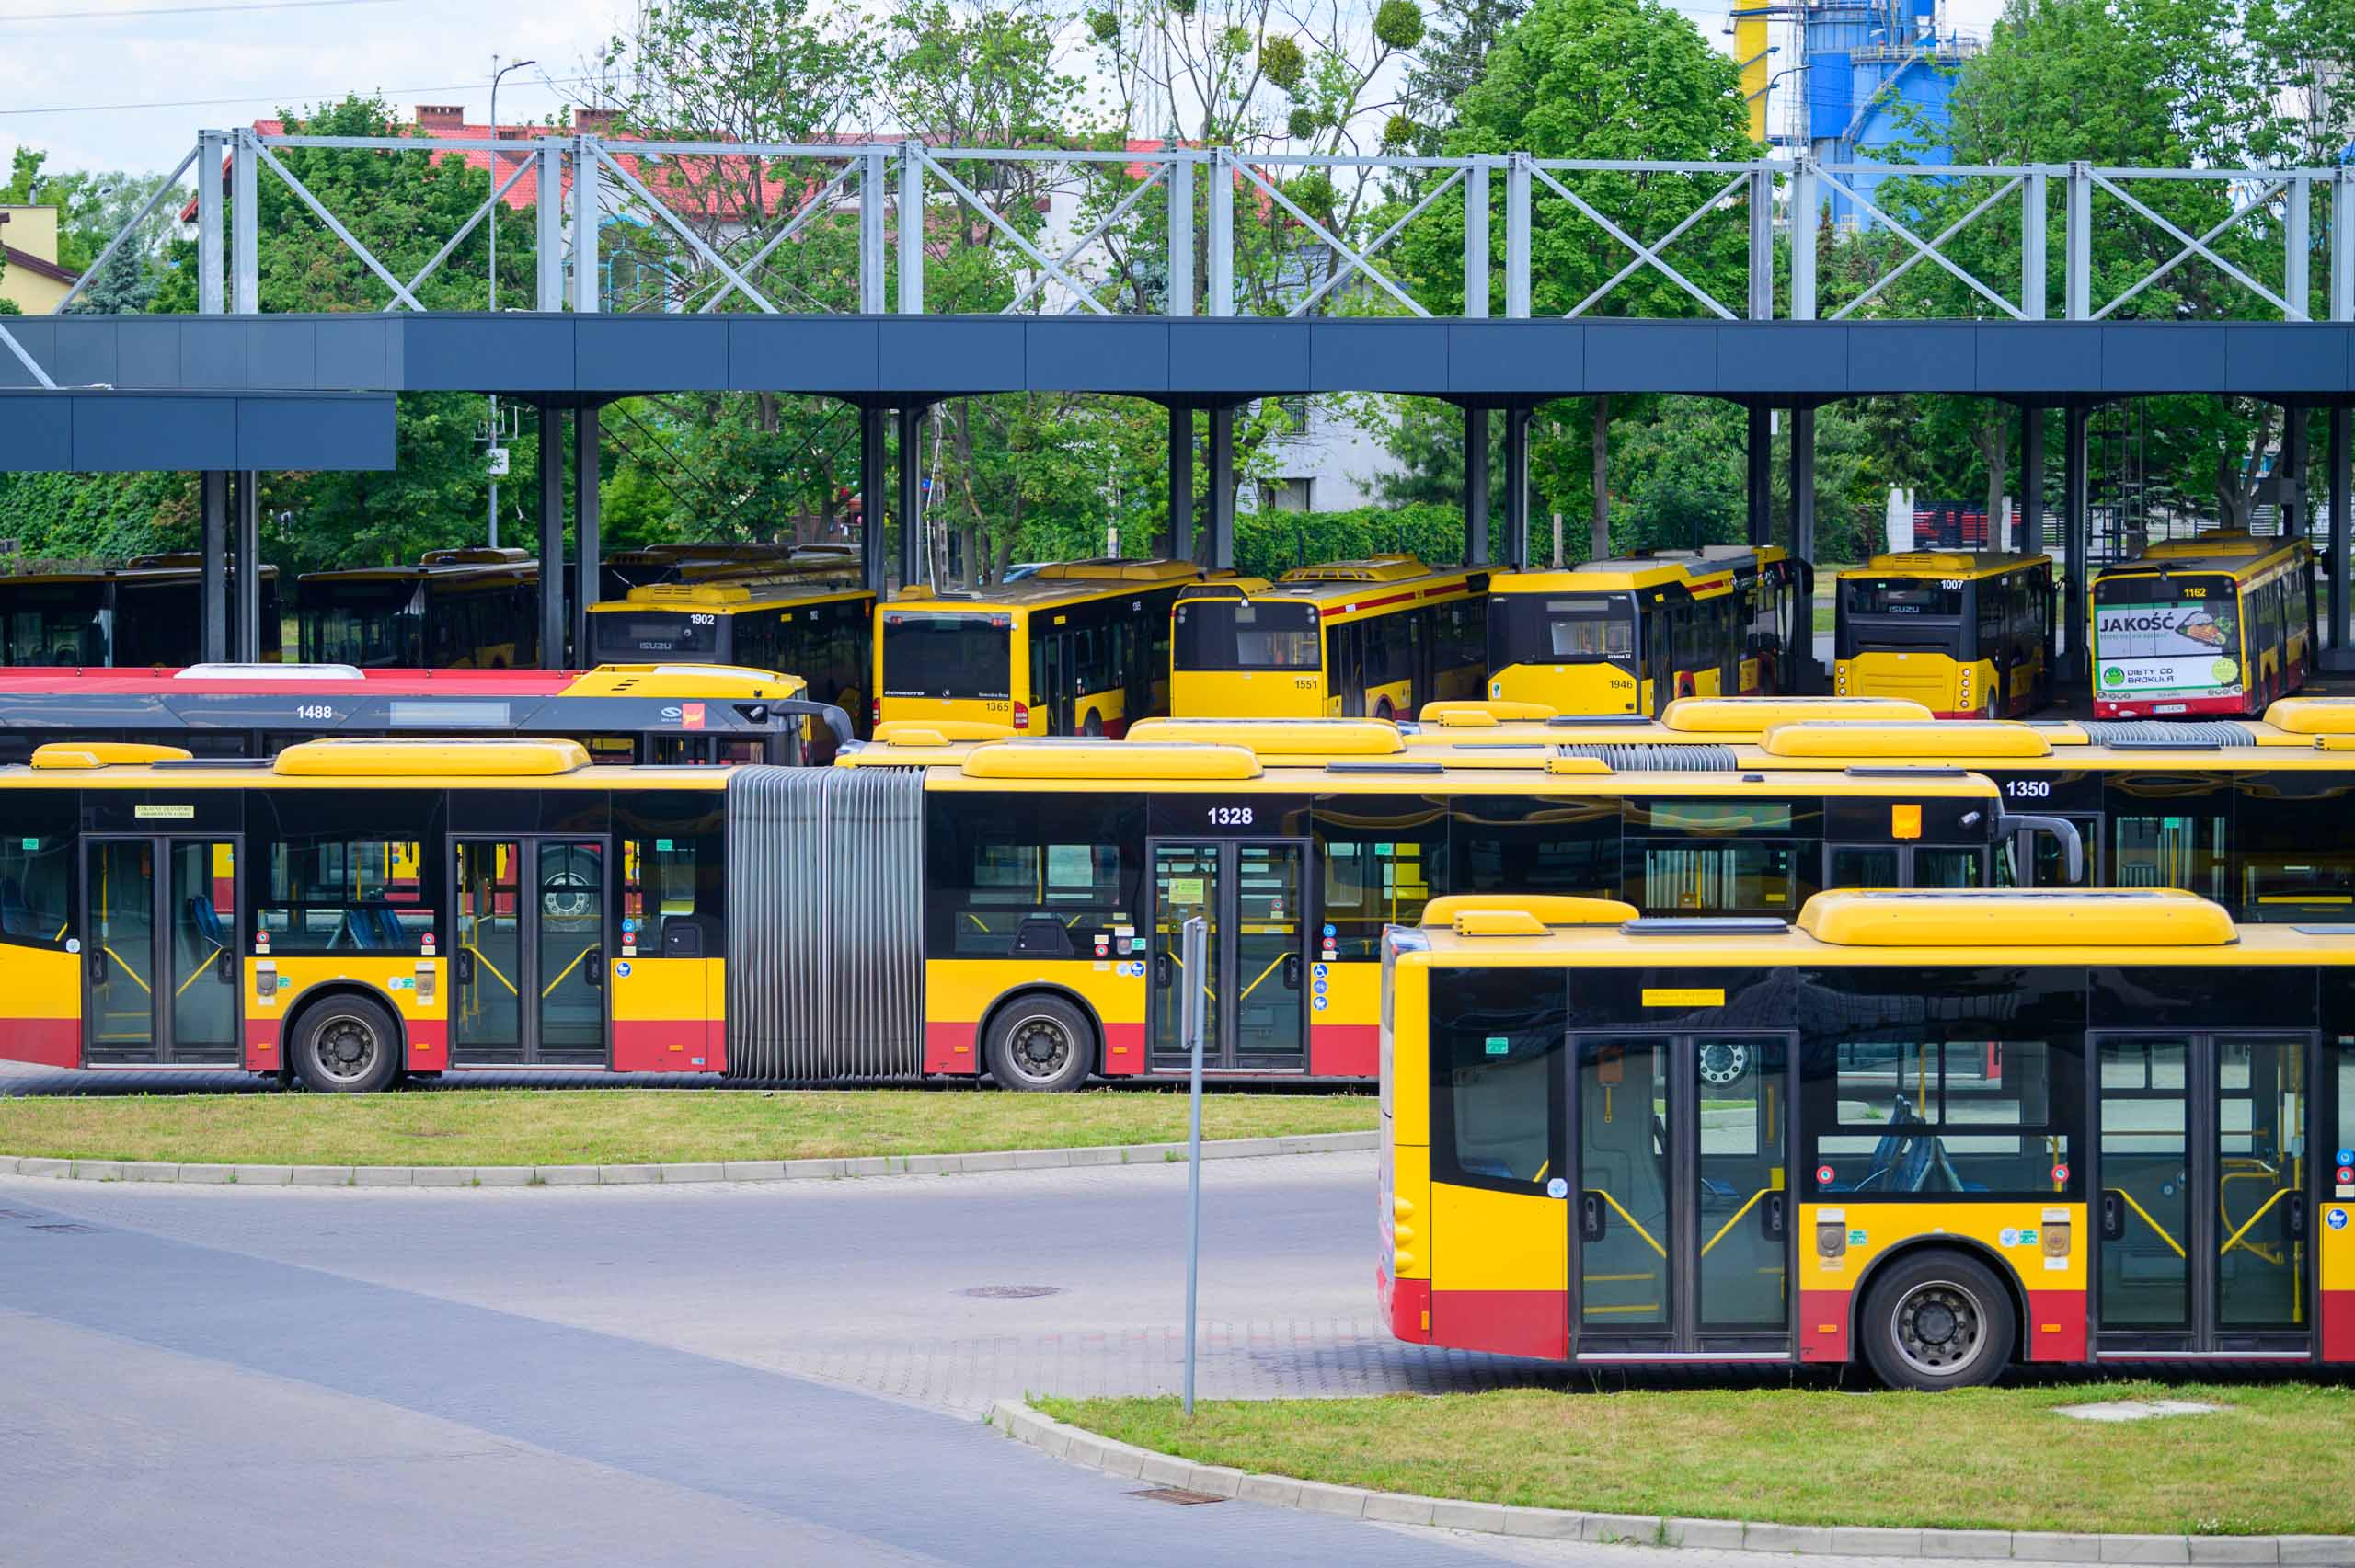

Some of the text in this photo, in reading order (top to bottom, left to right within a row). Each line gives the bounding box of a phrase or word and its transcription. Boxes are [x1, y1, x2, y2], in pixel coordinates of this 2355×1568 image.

[1941, 579, 1964, 589] 1007
[2184, 588, 2207, 598] 1162
[1889, 605, 1920, 613] ISUZU
[690, 613, 715, 624] 1902
[2099, 612, 2175, 632] JAKOŚĆ
[1295, 680, 1318, 690] 1551
[1610, 680, 1634, 689] 1946
[296, 705, 332, 719] 1488
[985, 702, 1009, 712] 1365
[2006, 781, 2050, 797] 1350
[1208, 807, 1253, 825] 1328
